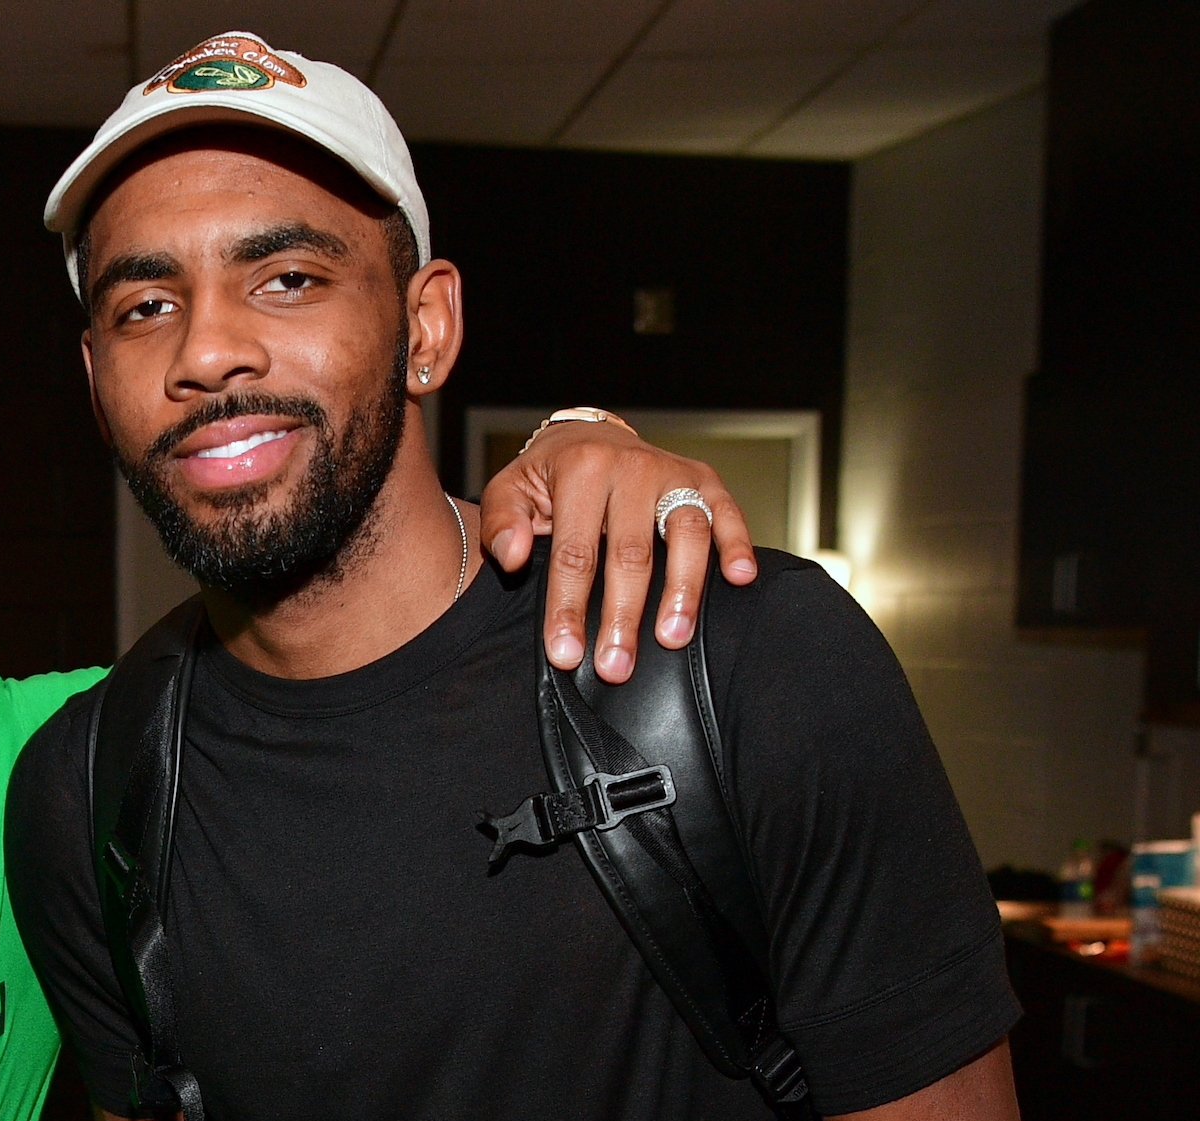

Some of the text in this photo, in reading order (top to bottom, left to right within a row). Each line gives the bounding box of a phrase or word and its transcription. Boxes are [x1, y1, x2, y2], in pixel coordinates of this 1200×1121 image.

[206, 40, 241, 49] The
[152, 47, 287, 83] Drunken Clam
